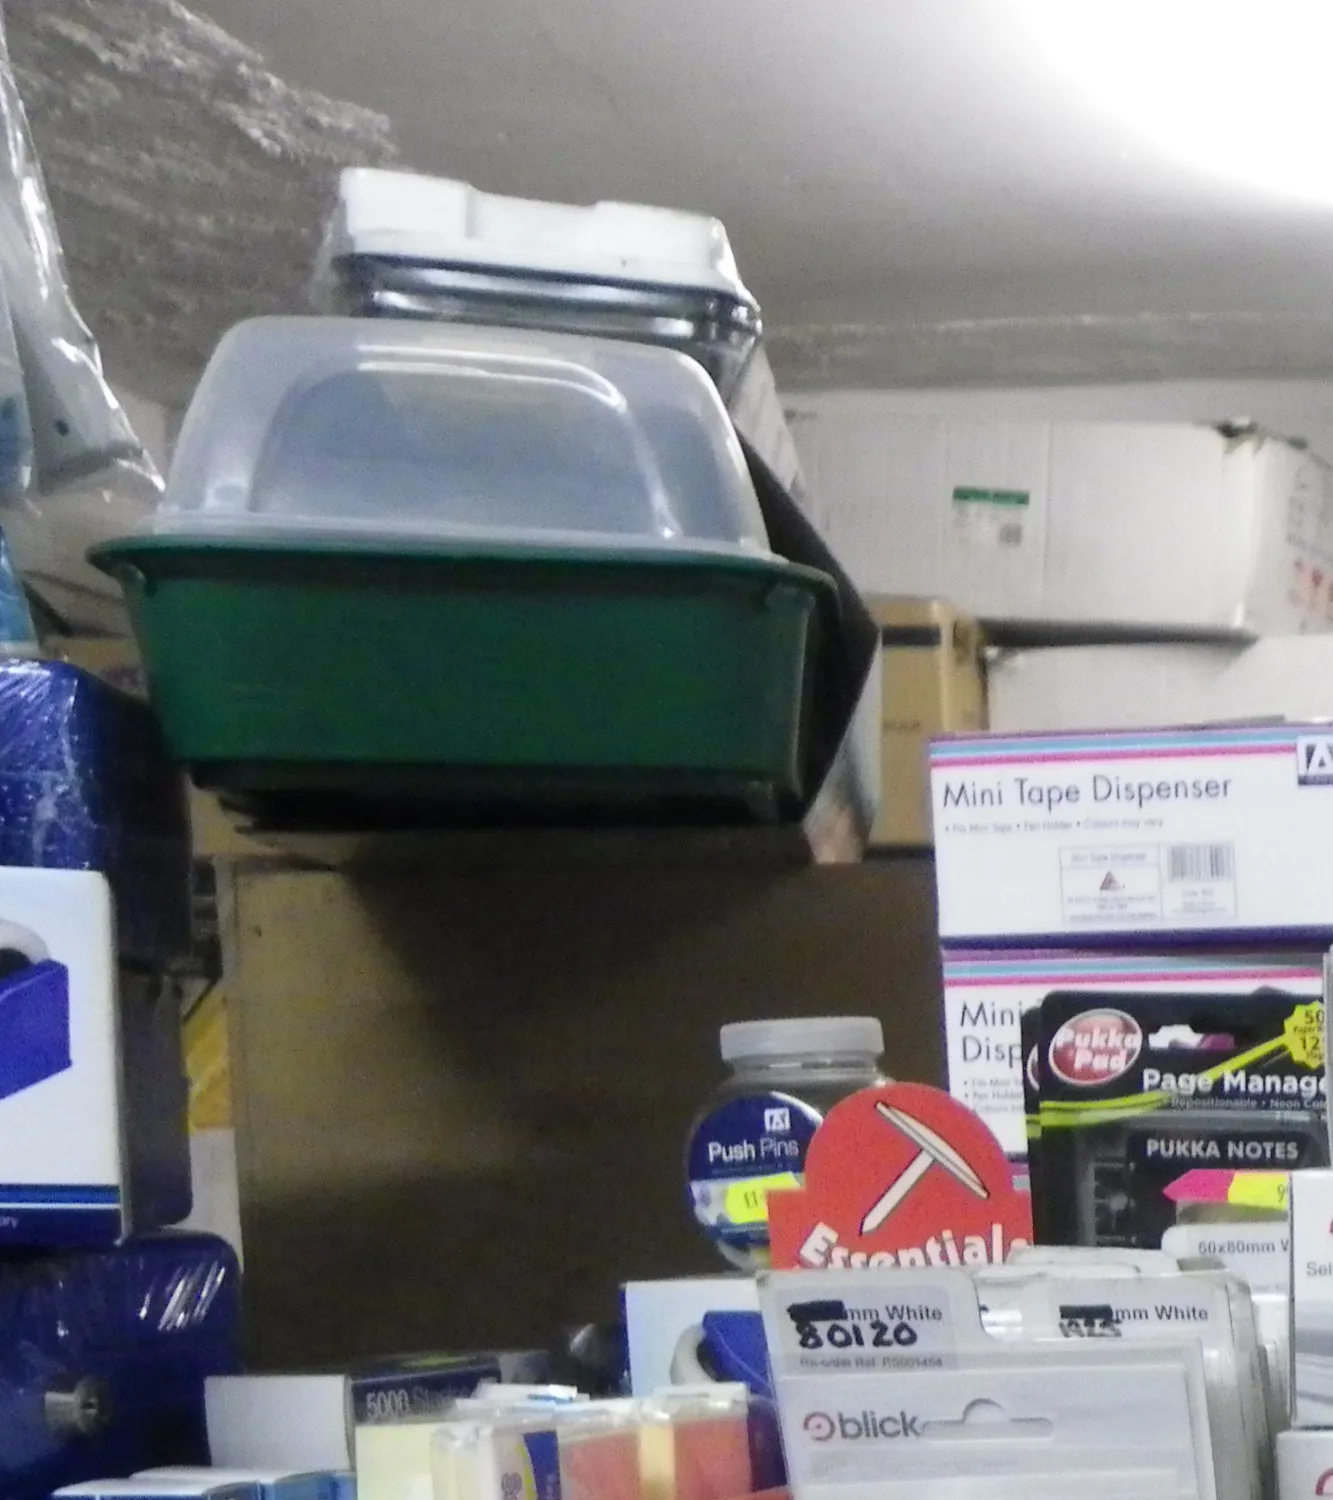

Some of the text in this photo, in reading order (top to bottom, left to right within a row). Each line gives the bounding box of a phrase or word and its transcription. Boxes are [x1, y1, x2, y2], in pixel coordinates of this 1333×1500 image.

[943, 774, 1233, 811] Mini Tape Dispenser
[960, 1001, 1022, 1027] Mini
[1054, 1026, 1140, 1050] Pukka
[1074, 1048, 1129, 1072] Pad
[1142, 1068, 1214, 1096] Page
[708, 1137, 799, 1163] Push Pins
[1147, 1139, 1299, 1160] PUKKA NOTES
[885, 1305, 943, 1321] White
[1155, 1305, 1209, 1321] White
[839, 1411, 923, 1441] blick
